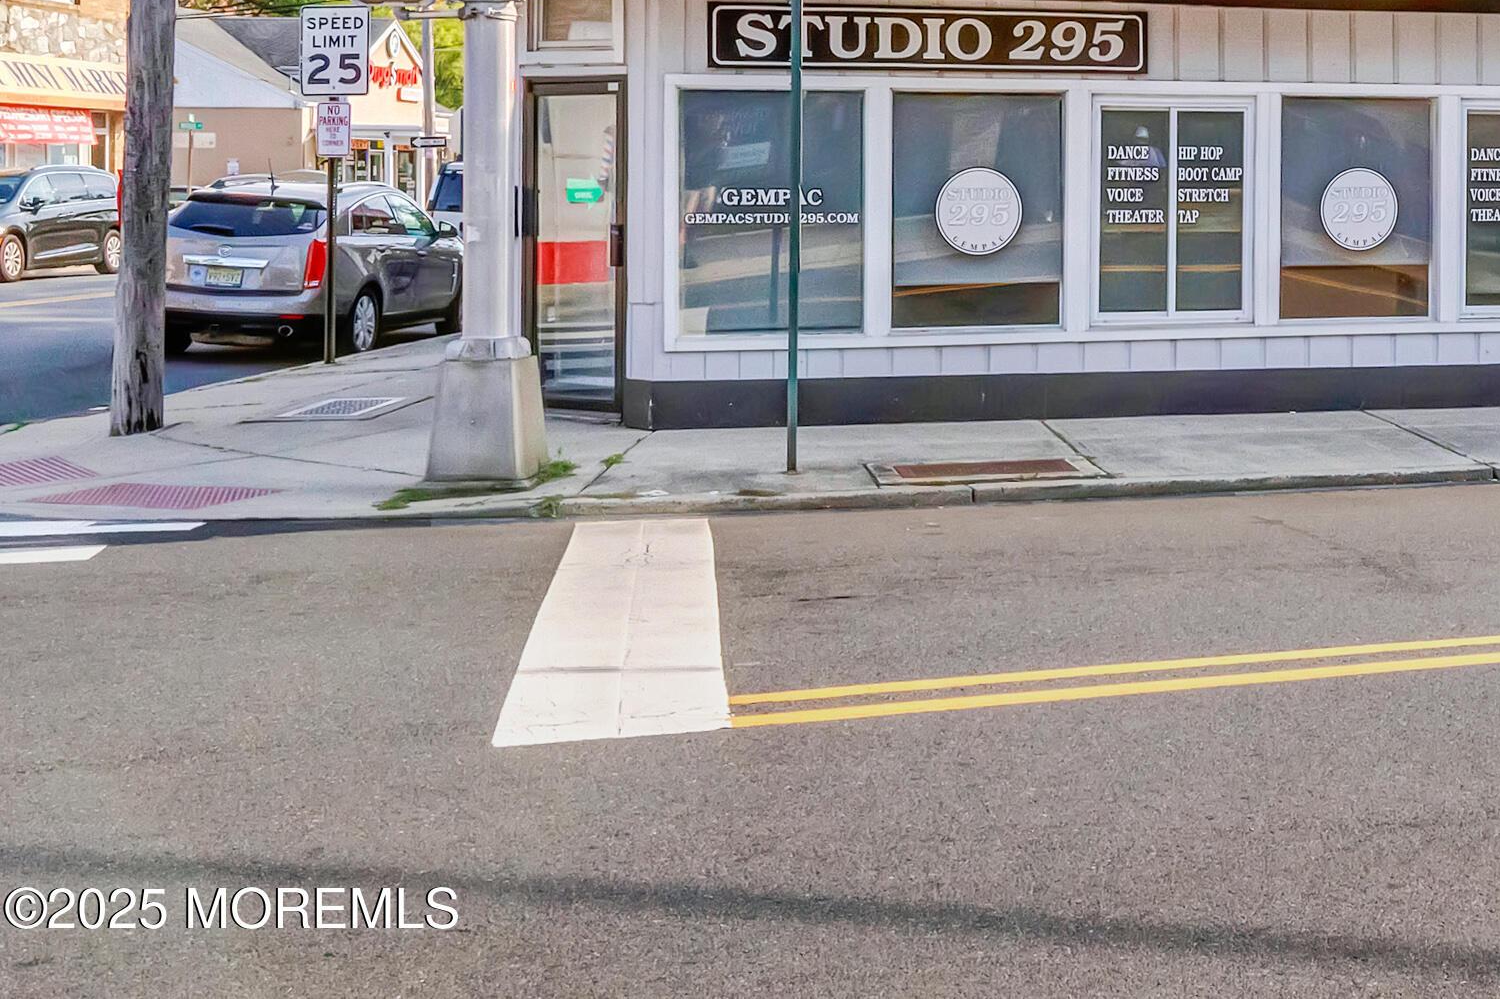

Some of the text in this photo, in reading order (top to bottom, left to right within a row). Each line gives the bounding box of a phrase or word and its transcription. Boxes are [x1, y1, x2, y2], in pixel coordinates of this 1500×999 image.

[307, 17, 364, 30] SPEED
[312, 35, 357, 48] LIMIT
[735, 12, 1126, 62] STUDIO 295
[4, 60, 63, 91] MINI
[307, 53, 362, 85] 25
[327, 106, 340, 115] NO
[319, 116, 348, 126] PARKING
[1106, 146, 1150, 159] DANCE
[1178, 146, 1224, 160] HIP HOP
[1106, 167, 1160, 181] FITNESS
[1178, 167, 1243, 181] BOOT CAMP
[946, 188, 1012, 202] STUDIO
[1106, 188, 1144, 202] VOICE
[1178, 188, 1230, 203] STRETCH
[1330, 186, 1389, 200] STUDIO
[684, 213, 859, 224] GEMPACSTUDI295.COM
[947, 203, 1010, 227] 295
[1106, 209, 1165, 224] THEATER
[1178, 210, 1200, 224] TAP
[1331, 200, 1388, 224] 295
